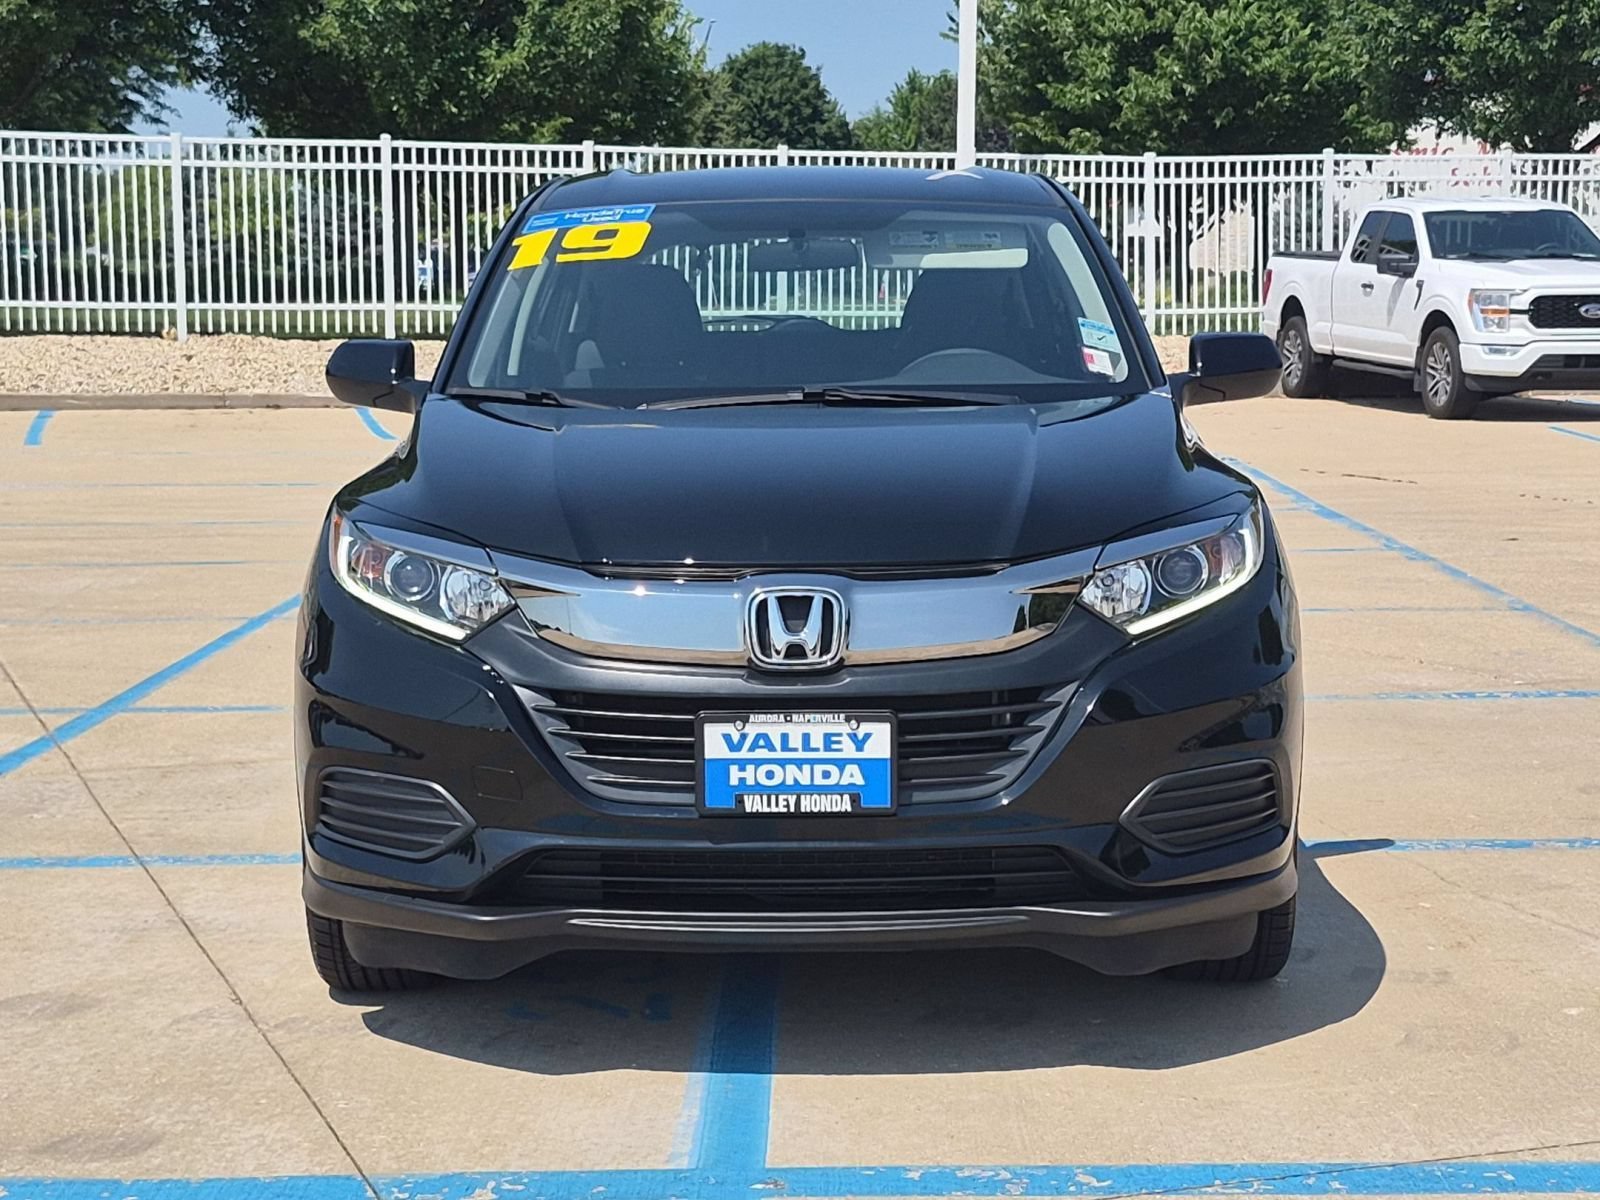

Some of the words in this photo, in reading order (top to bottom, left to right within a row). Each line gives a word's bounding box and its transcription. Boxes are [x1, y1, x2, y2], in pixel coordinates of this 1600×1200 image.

[507, 221, 652, 271] 19
[749, 714, 785, 723] AURORA
[791, 714, 846, 723] NAPERVILLE
[720, 732, 874, 753] VALLEY
[728, 763, 866, 786] HONDA
[743, 794, 798, 813] VALLEY
[799, 793, 852, 813] HONDA
